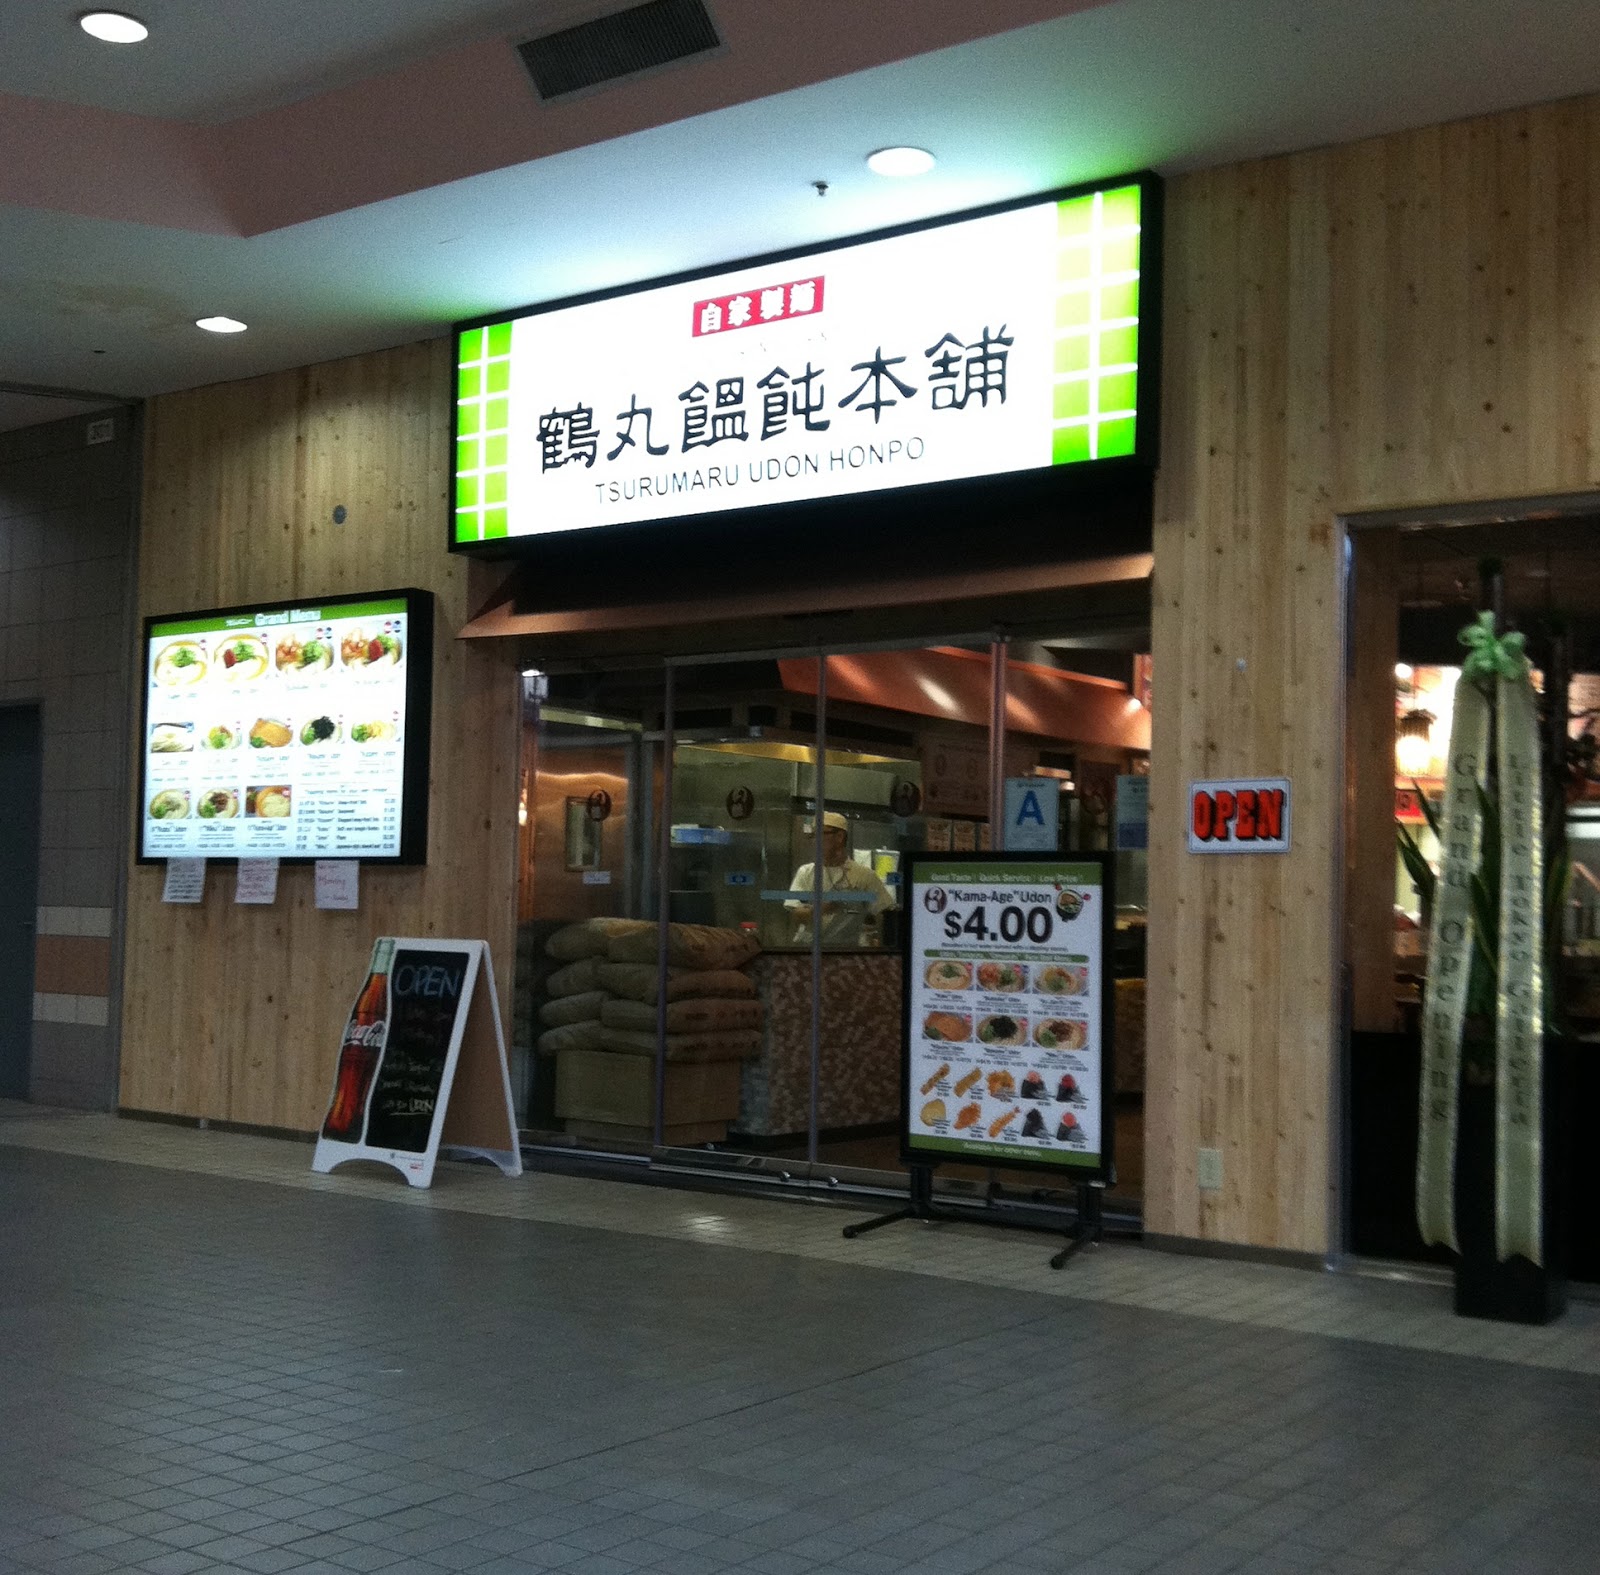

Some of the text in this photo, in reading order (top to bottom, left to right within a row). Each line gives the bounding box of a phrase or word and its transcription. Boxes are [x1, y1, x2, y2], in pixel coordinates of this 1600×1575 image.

[595, 437, 925, 503] TSURUMARU UDON HONPO
[1016, 790, 1046, 825] A
[1194, 788, 1286, 841] OPEN
[1020, 891, 1052, 903] Udon
[944, 905, 1053, 944] $4.00
[395, 965, 461, 997] OPEN
